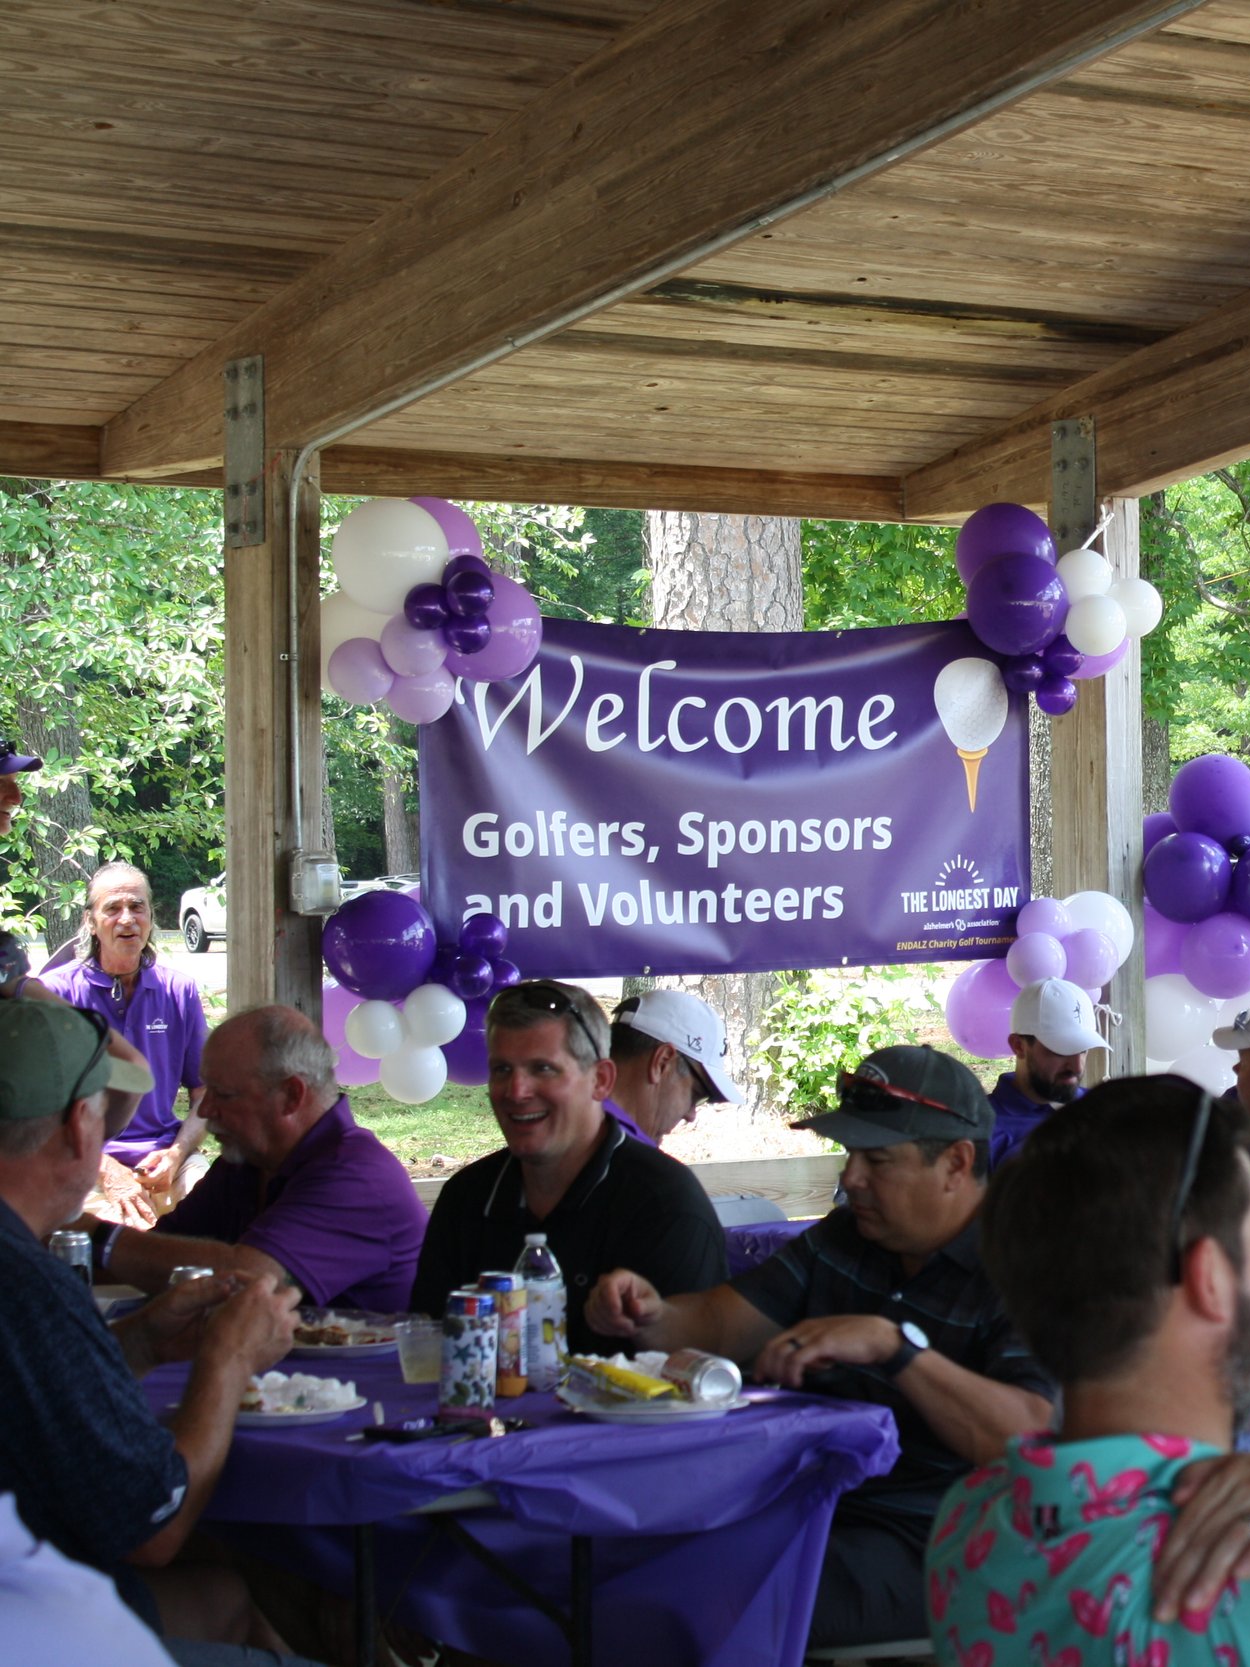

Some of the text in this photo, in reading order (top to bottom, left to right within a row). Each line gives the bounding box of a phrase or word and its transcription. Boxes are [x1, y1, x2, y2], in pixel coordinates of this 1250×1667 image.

[455, 654, 898, 756] Welcome
[462, 810, 893, 868] Golfers, Sponsors
[462, 879, 844, 930] and Volunteers
[901, 886, 1019, 913] THE LONGEST DAY
[966, 919, 999, 928] association
[896, 936, 1017, 951] ENDALZ Charity Golf Tourname
